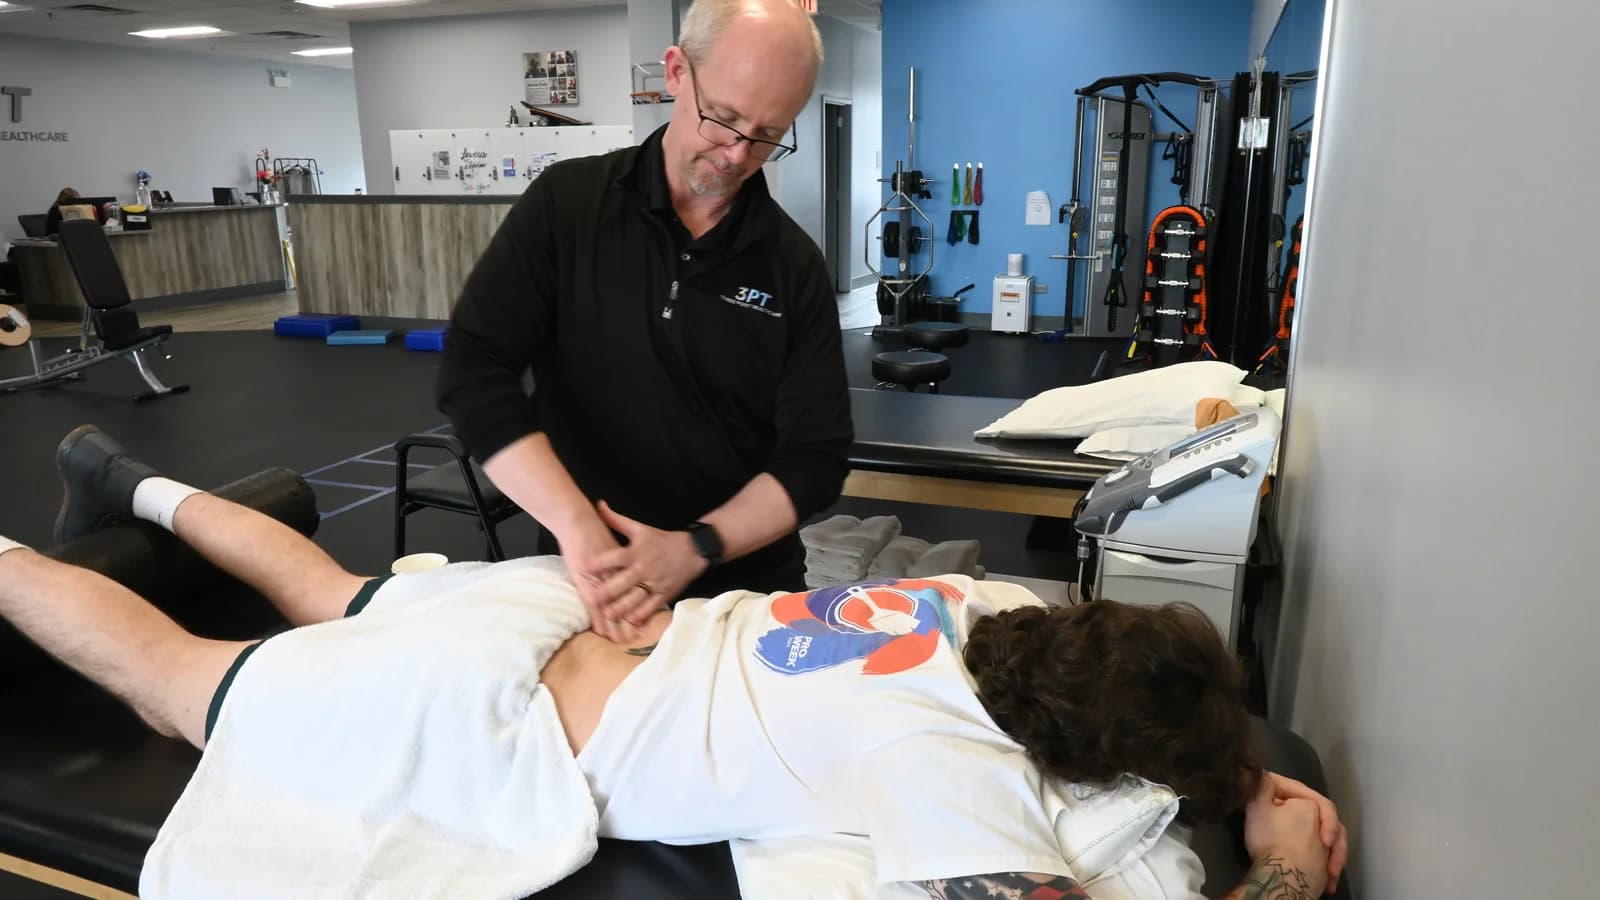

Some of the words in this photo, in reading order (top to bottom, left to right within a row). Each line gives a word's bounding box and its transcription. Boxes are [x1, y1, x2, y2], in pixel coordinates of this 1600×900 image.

[0, 131, 69, 142] EALTHCARE
[735, 286, 773, 307] 3PT
[786, 635, 804, 668] WEEK
[798, 635, 813, 658] PRO
